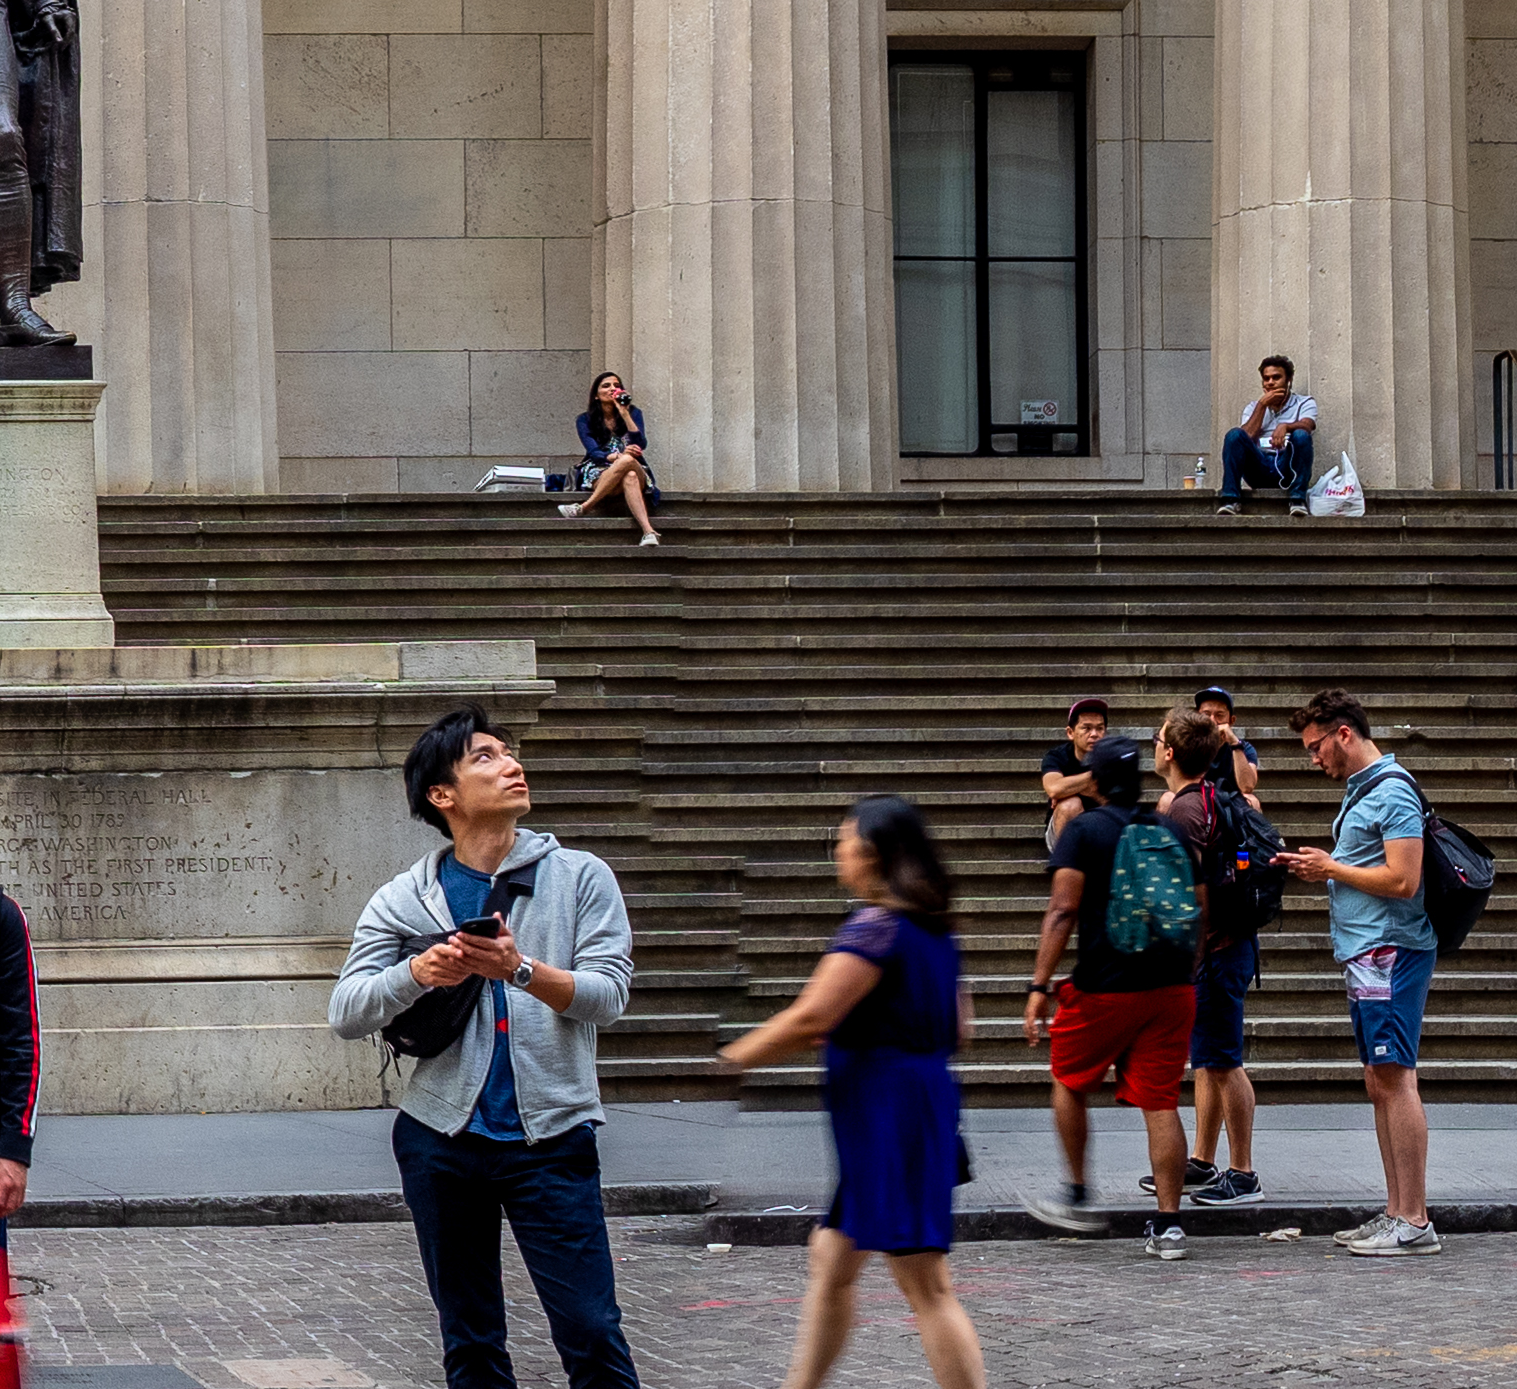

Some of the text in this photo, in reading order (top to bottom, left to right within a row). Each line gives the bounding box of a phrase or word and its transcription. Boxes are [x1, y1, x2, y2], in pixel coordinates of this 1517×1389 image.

[43, 791, 61, 806] IN
[67, 790, 154, 806] FEDERAL
[162, 789, 212, 805] HALL
[40, 836, 173, 852] WASHINGTON
[27, 860, 52, 875] AS
[62, 860, 98, 874] THE
[107, 859, 155, 874] FIRST
[33, 882, 103, 898] UNITED
[111, 881, 177, 897] STATES
[38, 905, 127, 921] AMERICA
